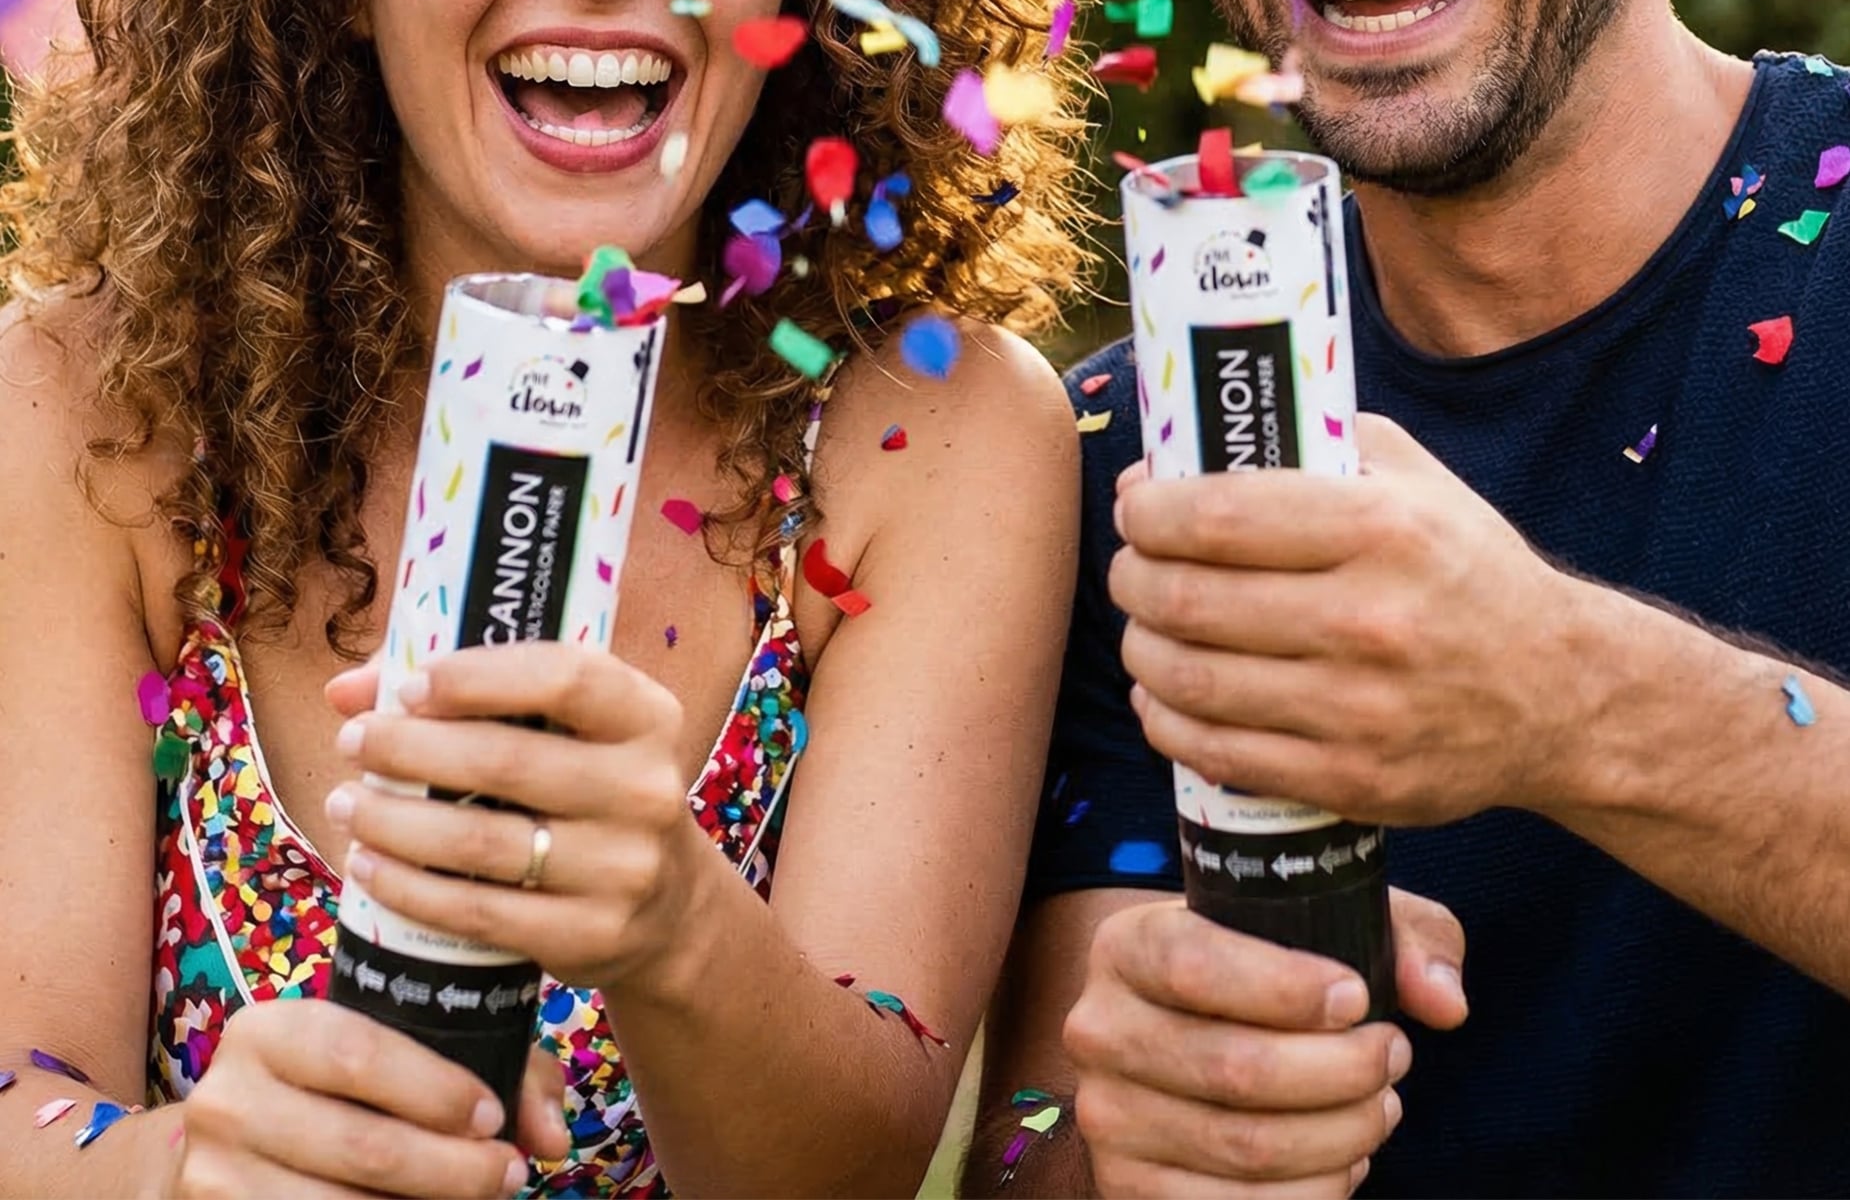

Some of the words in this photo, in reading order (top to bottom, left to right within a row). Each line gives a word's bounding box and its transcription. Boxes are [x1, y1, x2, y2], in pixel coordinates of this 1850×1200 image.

[1200, 265, 1270, 291] clown
[510, 386, 582, 418] clown
[1217, 349, 1259, 472] NNON
[1261, 410, 1281, 469] COLOR
[483, 472, 544, 649] CANNON
[525, 540, 558, 646] ULTICOLOR
